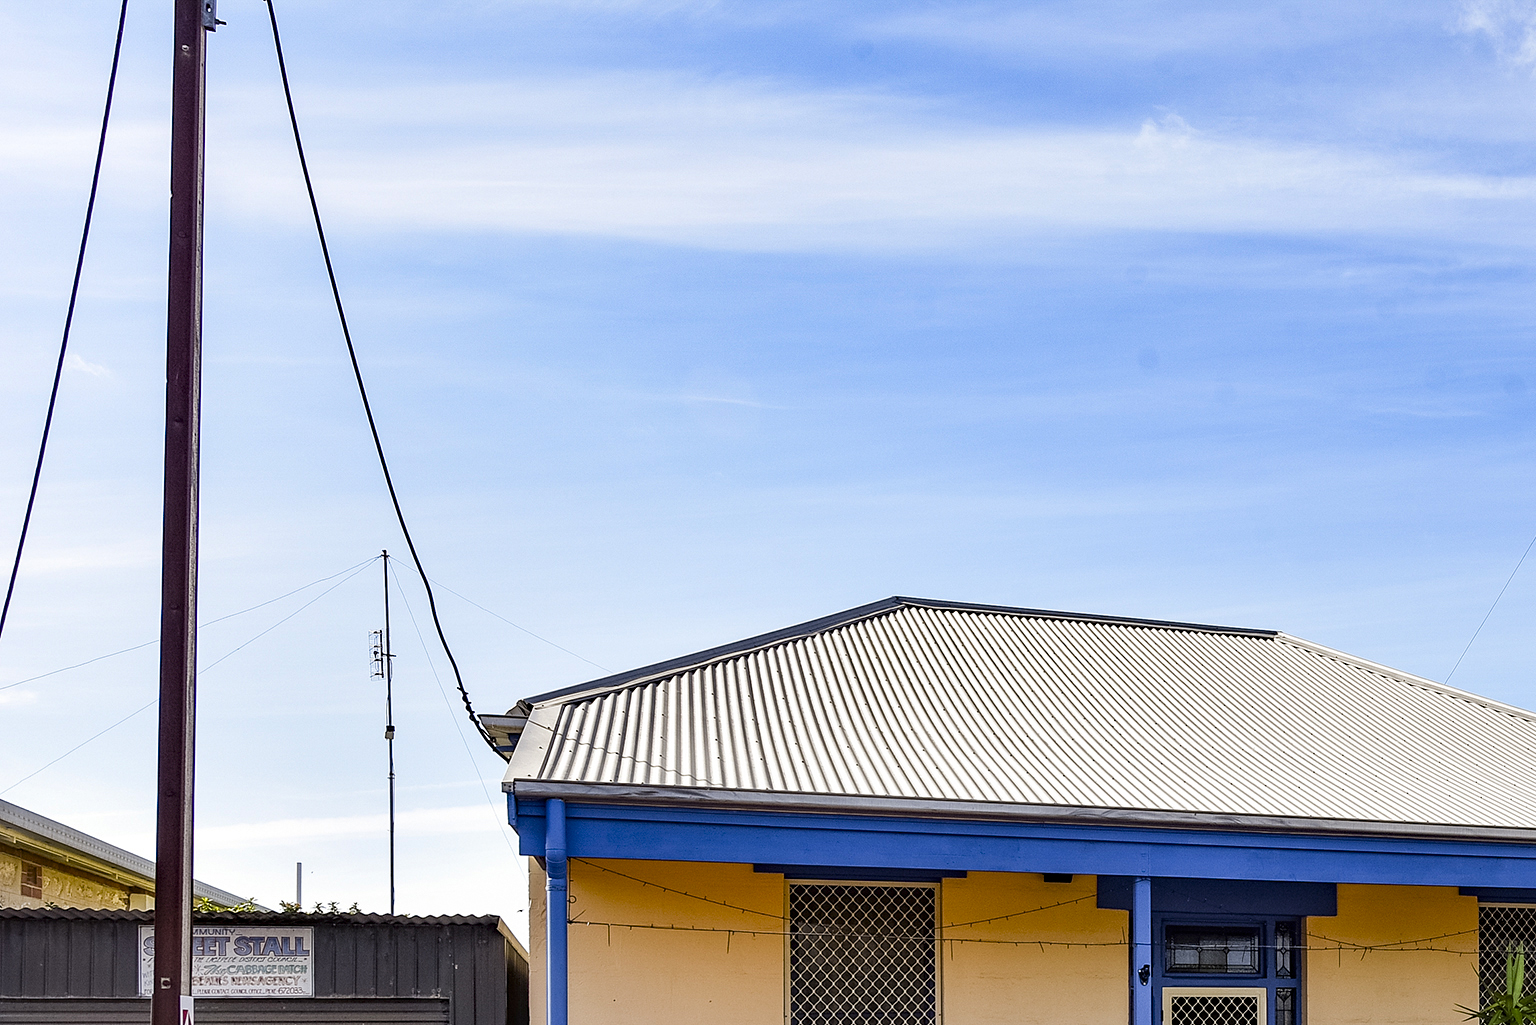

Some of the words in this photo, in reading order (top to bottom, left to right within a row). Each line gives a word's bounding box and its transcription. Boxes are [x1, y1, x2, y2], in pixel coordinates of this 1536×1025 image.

[143, 936, 230, 956] SEET
[233, 936, 310, 956] STALL
[227, 964, 277, 975] CABBAGE
